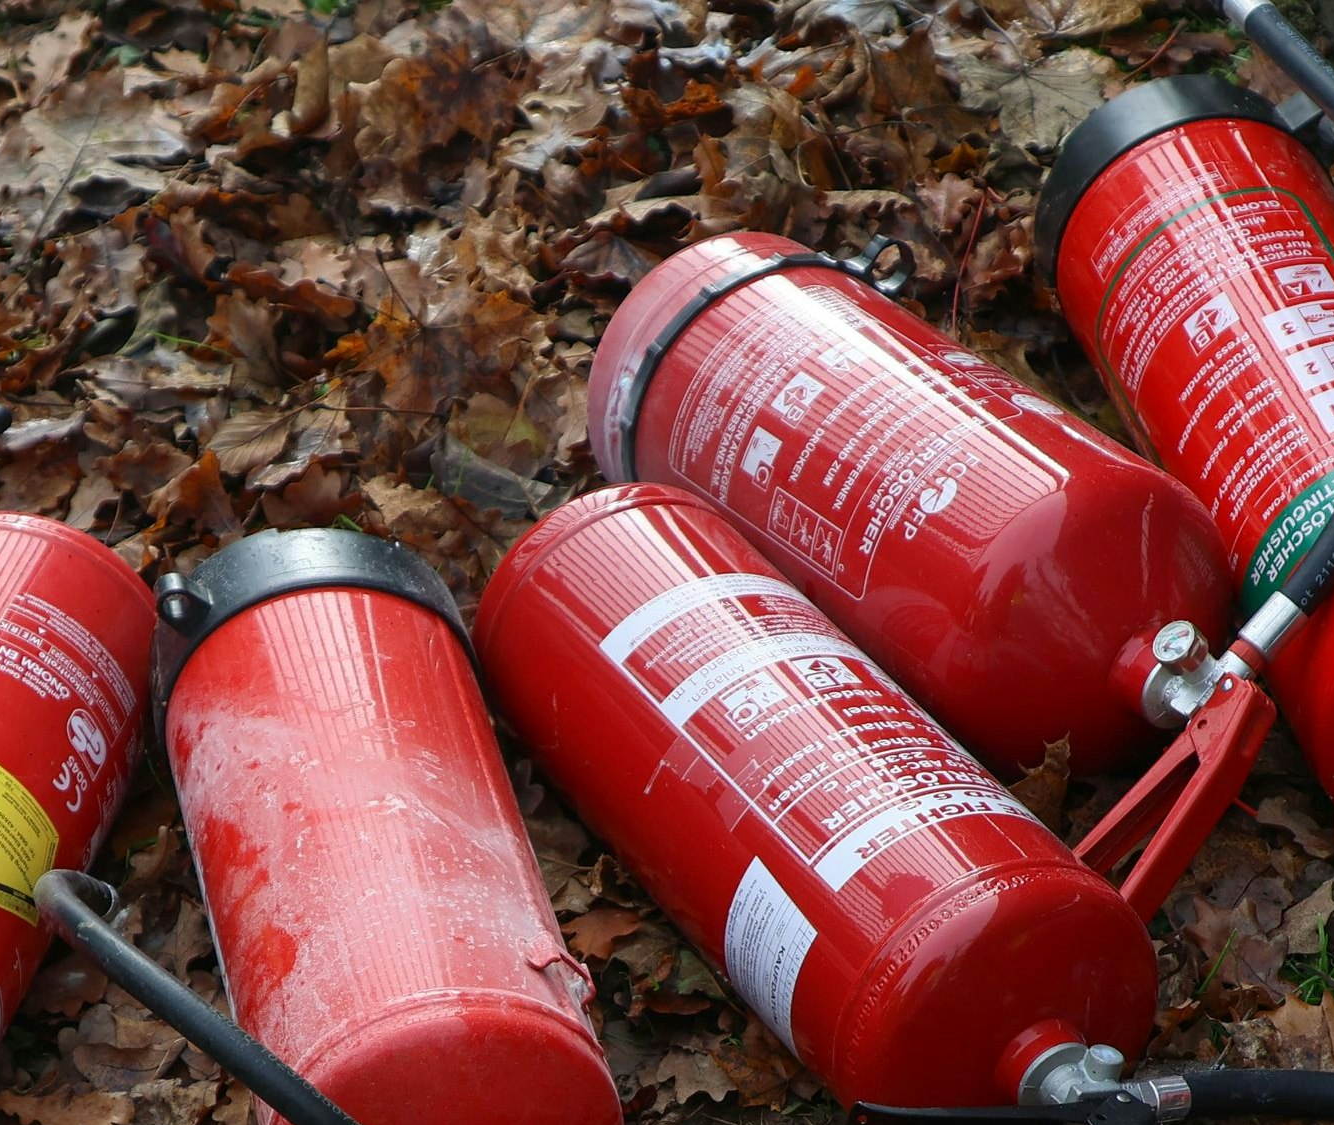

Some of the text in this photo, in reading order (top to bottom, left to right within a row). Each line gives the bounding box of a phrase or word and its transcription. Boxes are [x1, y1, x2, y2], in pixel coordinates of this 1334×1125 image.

[1172, 198, 1281, 242] GLORIA GmbH
[1198, 214, 1266, 245] Minimum
[1235, 227, 1306, 247] Attention
[1127, 226, 1251, 324] Only up to 1000 volts.
[1145, 239, 1198, 285] distance
[1161, 249, 1219, 296] presence
[1147, 293, 1163, 312] of
[1154, 247, 1312, 338] Vorsicht bei elektrischen
[1285, 282, 1302, 295] A
[1131, 270, 1209, 362] Mindestabstand
[1193, 329, 1211, 349] B
[1175, 318, 1298, 454] 3 Betätigungshebel
[1177, 330, 1250, 404] Press handle.
[1202, 341, 1258, 389] drücken.
[714, 358, 780, 464] MINDESTABSTAND
[733, 354, 798, 439] ELEKTRISCHEN
[785, 404, 803, 423] B
[1197, 359, 1321, 481] 2 Schlauch fassen.
[1213, 374, 1275, 432] Take hose.
[786, 426, 826, 483] DRÜCKEN.
[821, 401, 894, 487] FASSEN UND ZUM
[1216, 411, 1297, 497] Remove safety
[1226, 423, 1304, 502] herausziehen.
[754, 463, 771, 483] C
[830, 443, 879, 512] ENTFERNEN.
[858, 416, 984, 555] FEUERLÖSCHER
[866, 447, 916, 510] ABC PULVER
[1226, 431, 1310, 522] Sicherungsstift
[1291, 454, 1334, 487] SCHAUM
[888, 478, 926, 530] Fire Protection
[1259, 489, 1288, 520] FOAM
[2, 657, 24, 673] auch
[18, 655, 71, 698] ÖNORM
[20, 675, 47, 698] Dieses
[23, 669, 61, 700] entspricht
[37, 650, 95, 706] Endkontrolle
[685, 660, 746, 706] Anlagen.
[727, 703, 753, 727] C
[742, 687, 883, 742] niederdrücken
[842, 704, 898, 718] Hebel
[67, 715, 106, 765] GS
[759, 719, 915, 789] Schlauch fassen
[52, 761, 81, 812] CE
[65, 754, 88, 790] 0045
[766, 734, 931, 813] Sicherung ziehen
[820, 748, 925, 793] 233B C
[841, 758, 943, 793] ABC-Pulver
[853, 799, 993, 860] FIGHTER
